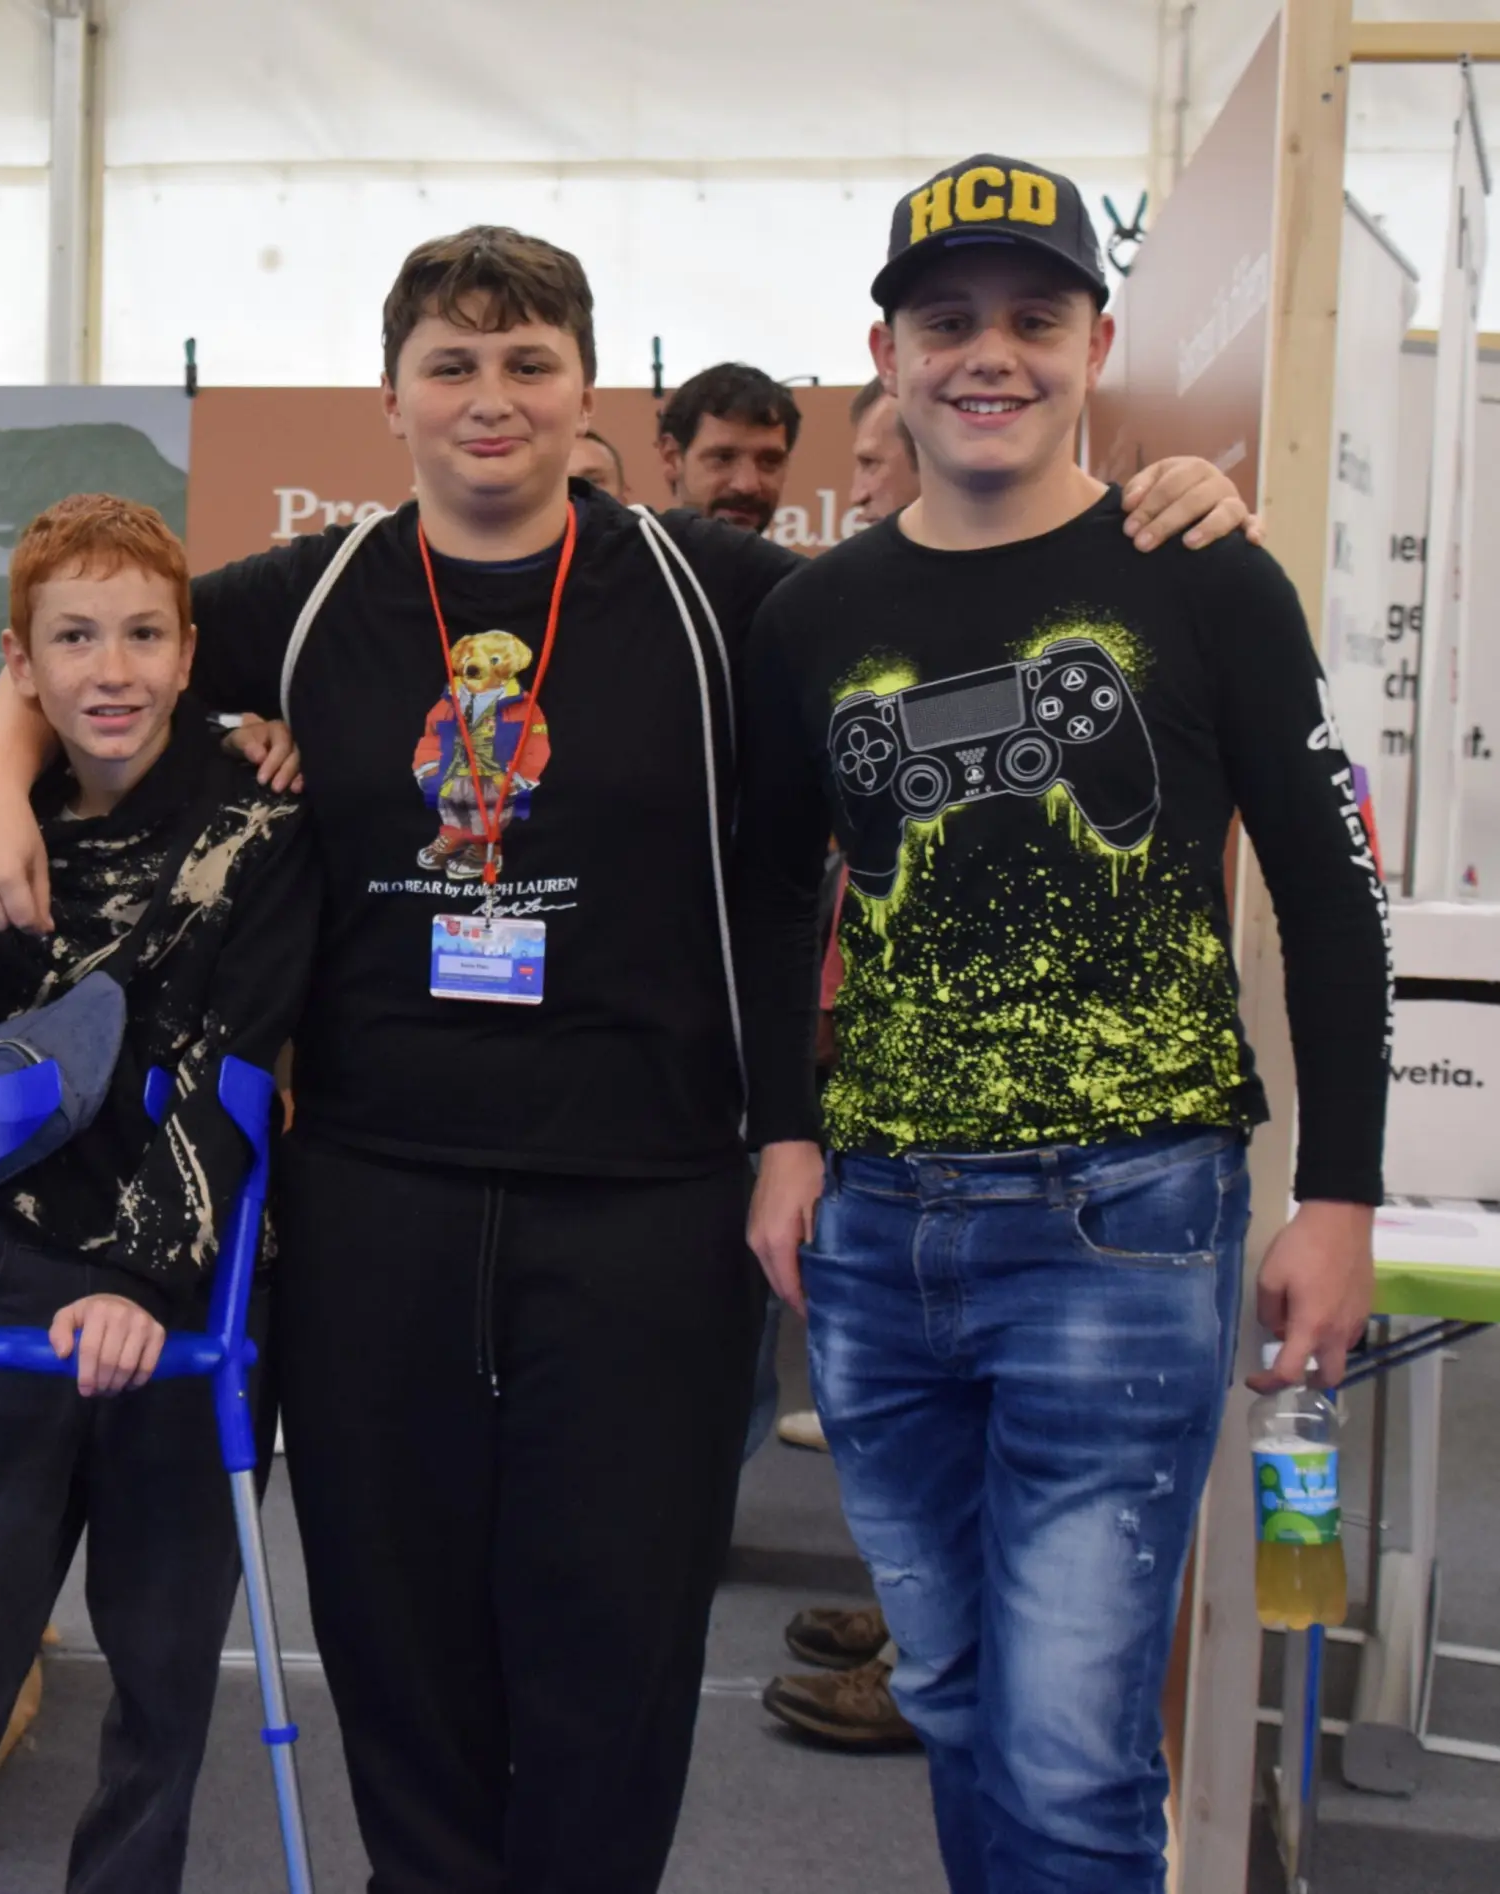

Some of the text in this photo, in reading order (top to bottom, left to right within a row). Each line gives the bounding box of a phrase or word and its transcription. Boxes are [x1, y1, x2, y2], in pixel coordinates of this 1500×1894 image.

[910, 166, 1057, 246] HCD
[368, 880, 404, 893] POLO
[405, 880, 443, 894] BEAR
[444, 882, 462, 898] by
[516, 877, 578, 895] LAUREN
[1389, 1059, 1484, 1089] vetia.
